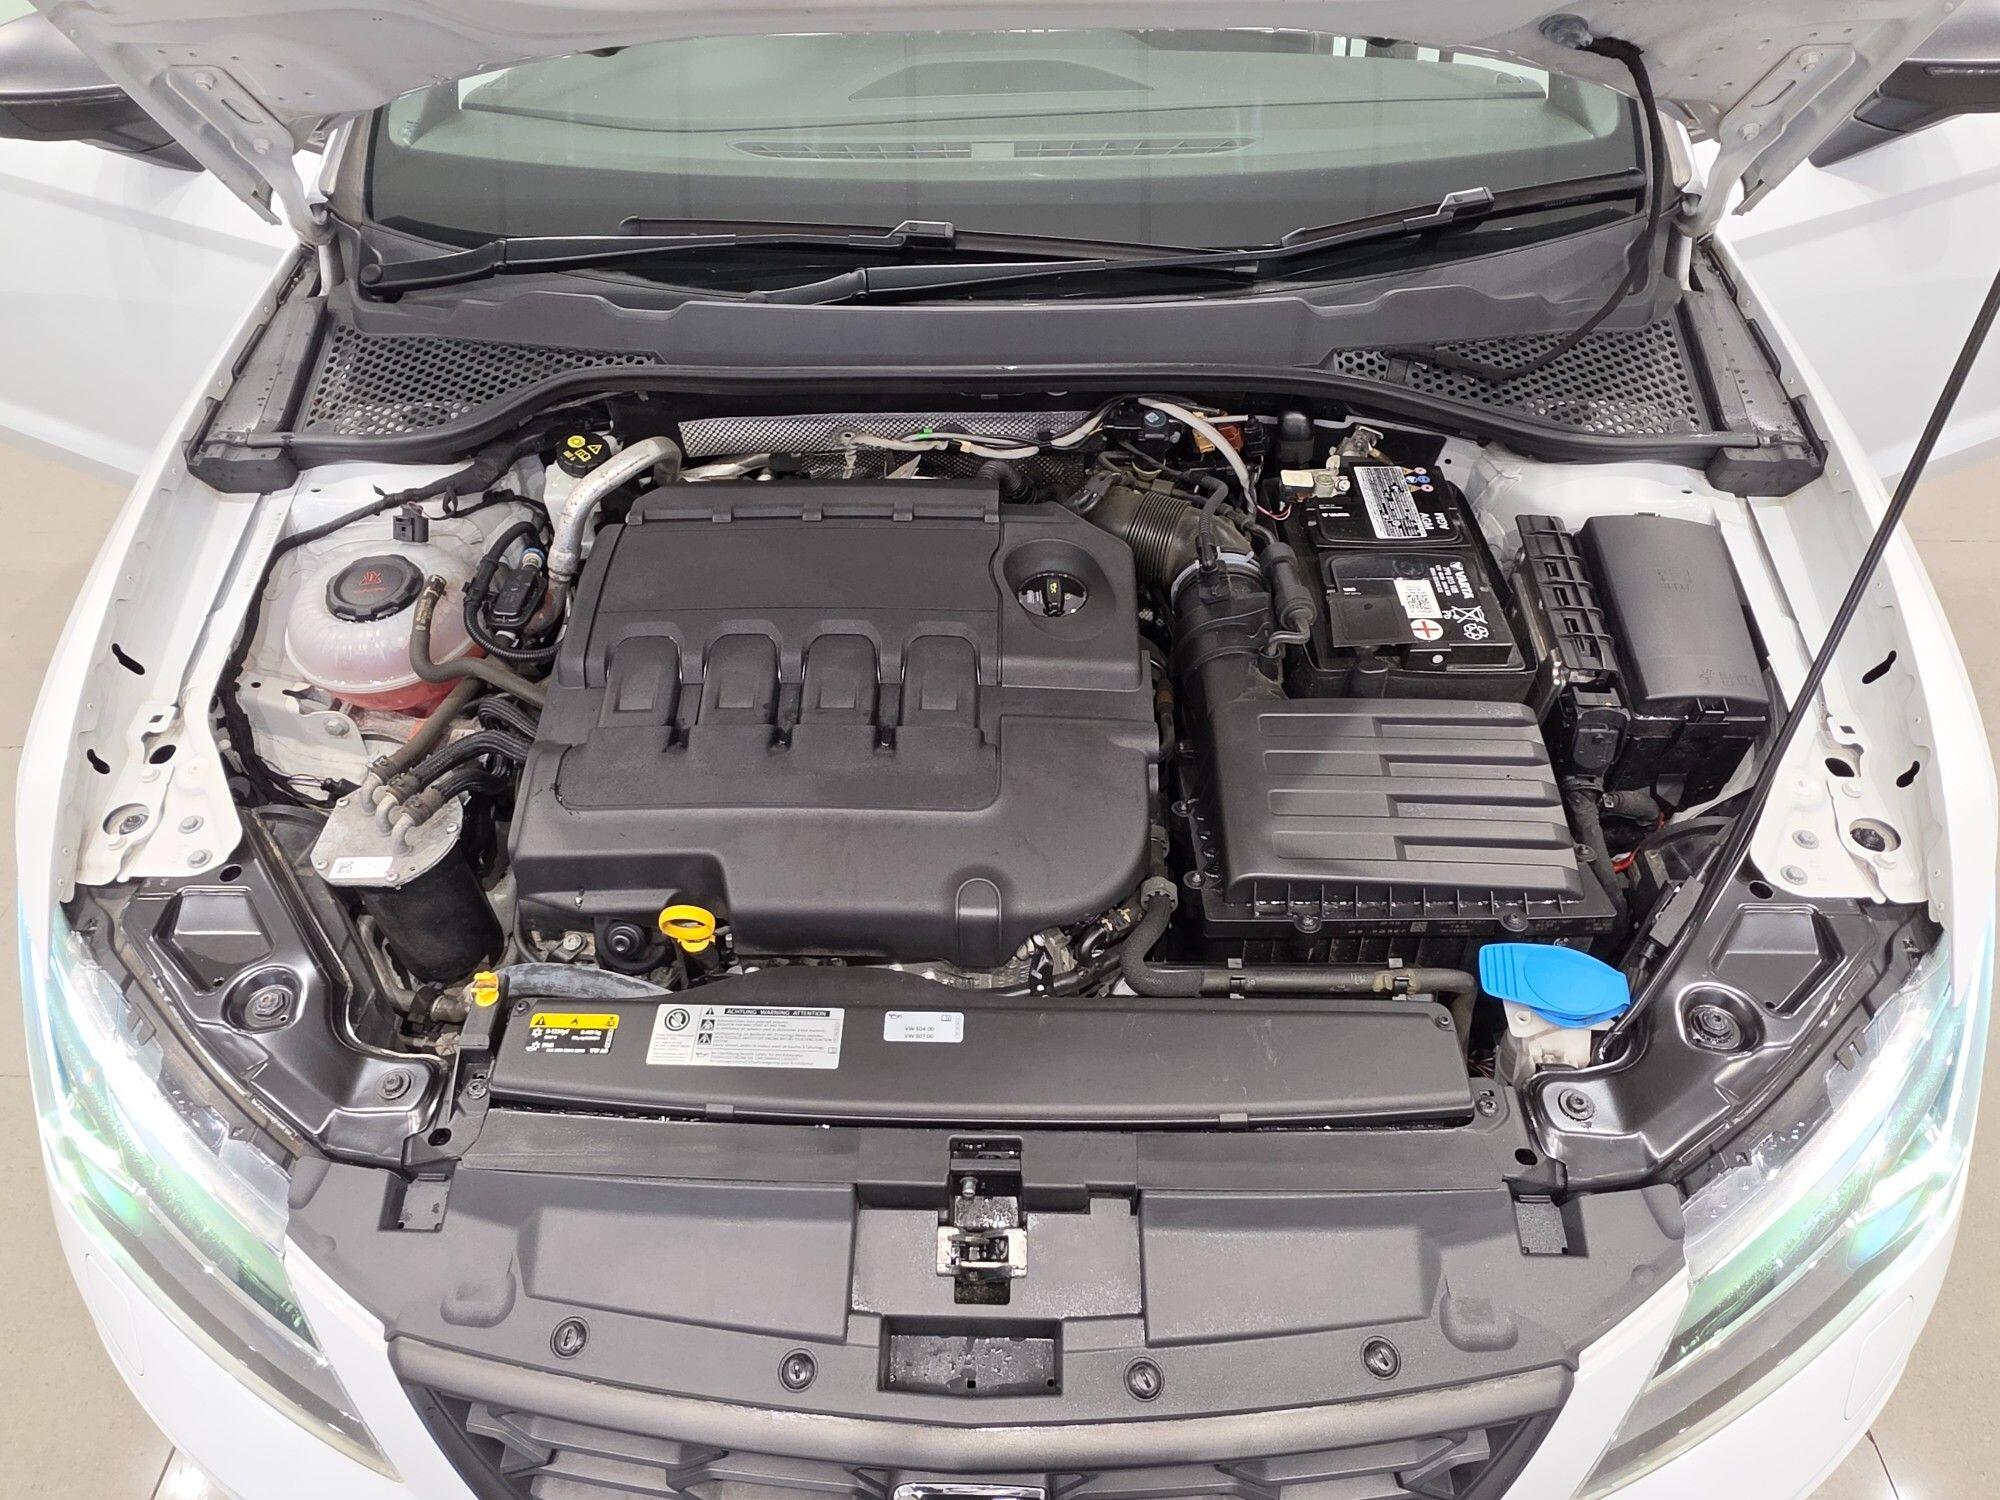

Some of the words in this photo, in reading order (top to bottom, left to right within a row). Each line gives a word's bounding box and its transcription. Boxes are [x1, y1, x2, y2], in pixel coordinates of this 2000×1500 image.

[1419, 512, 1435, 530] AGM
[1434, 512, 1451, 530] AGM
[1454, 570, 1475, 599] VARTA
